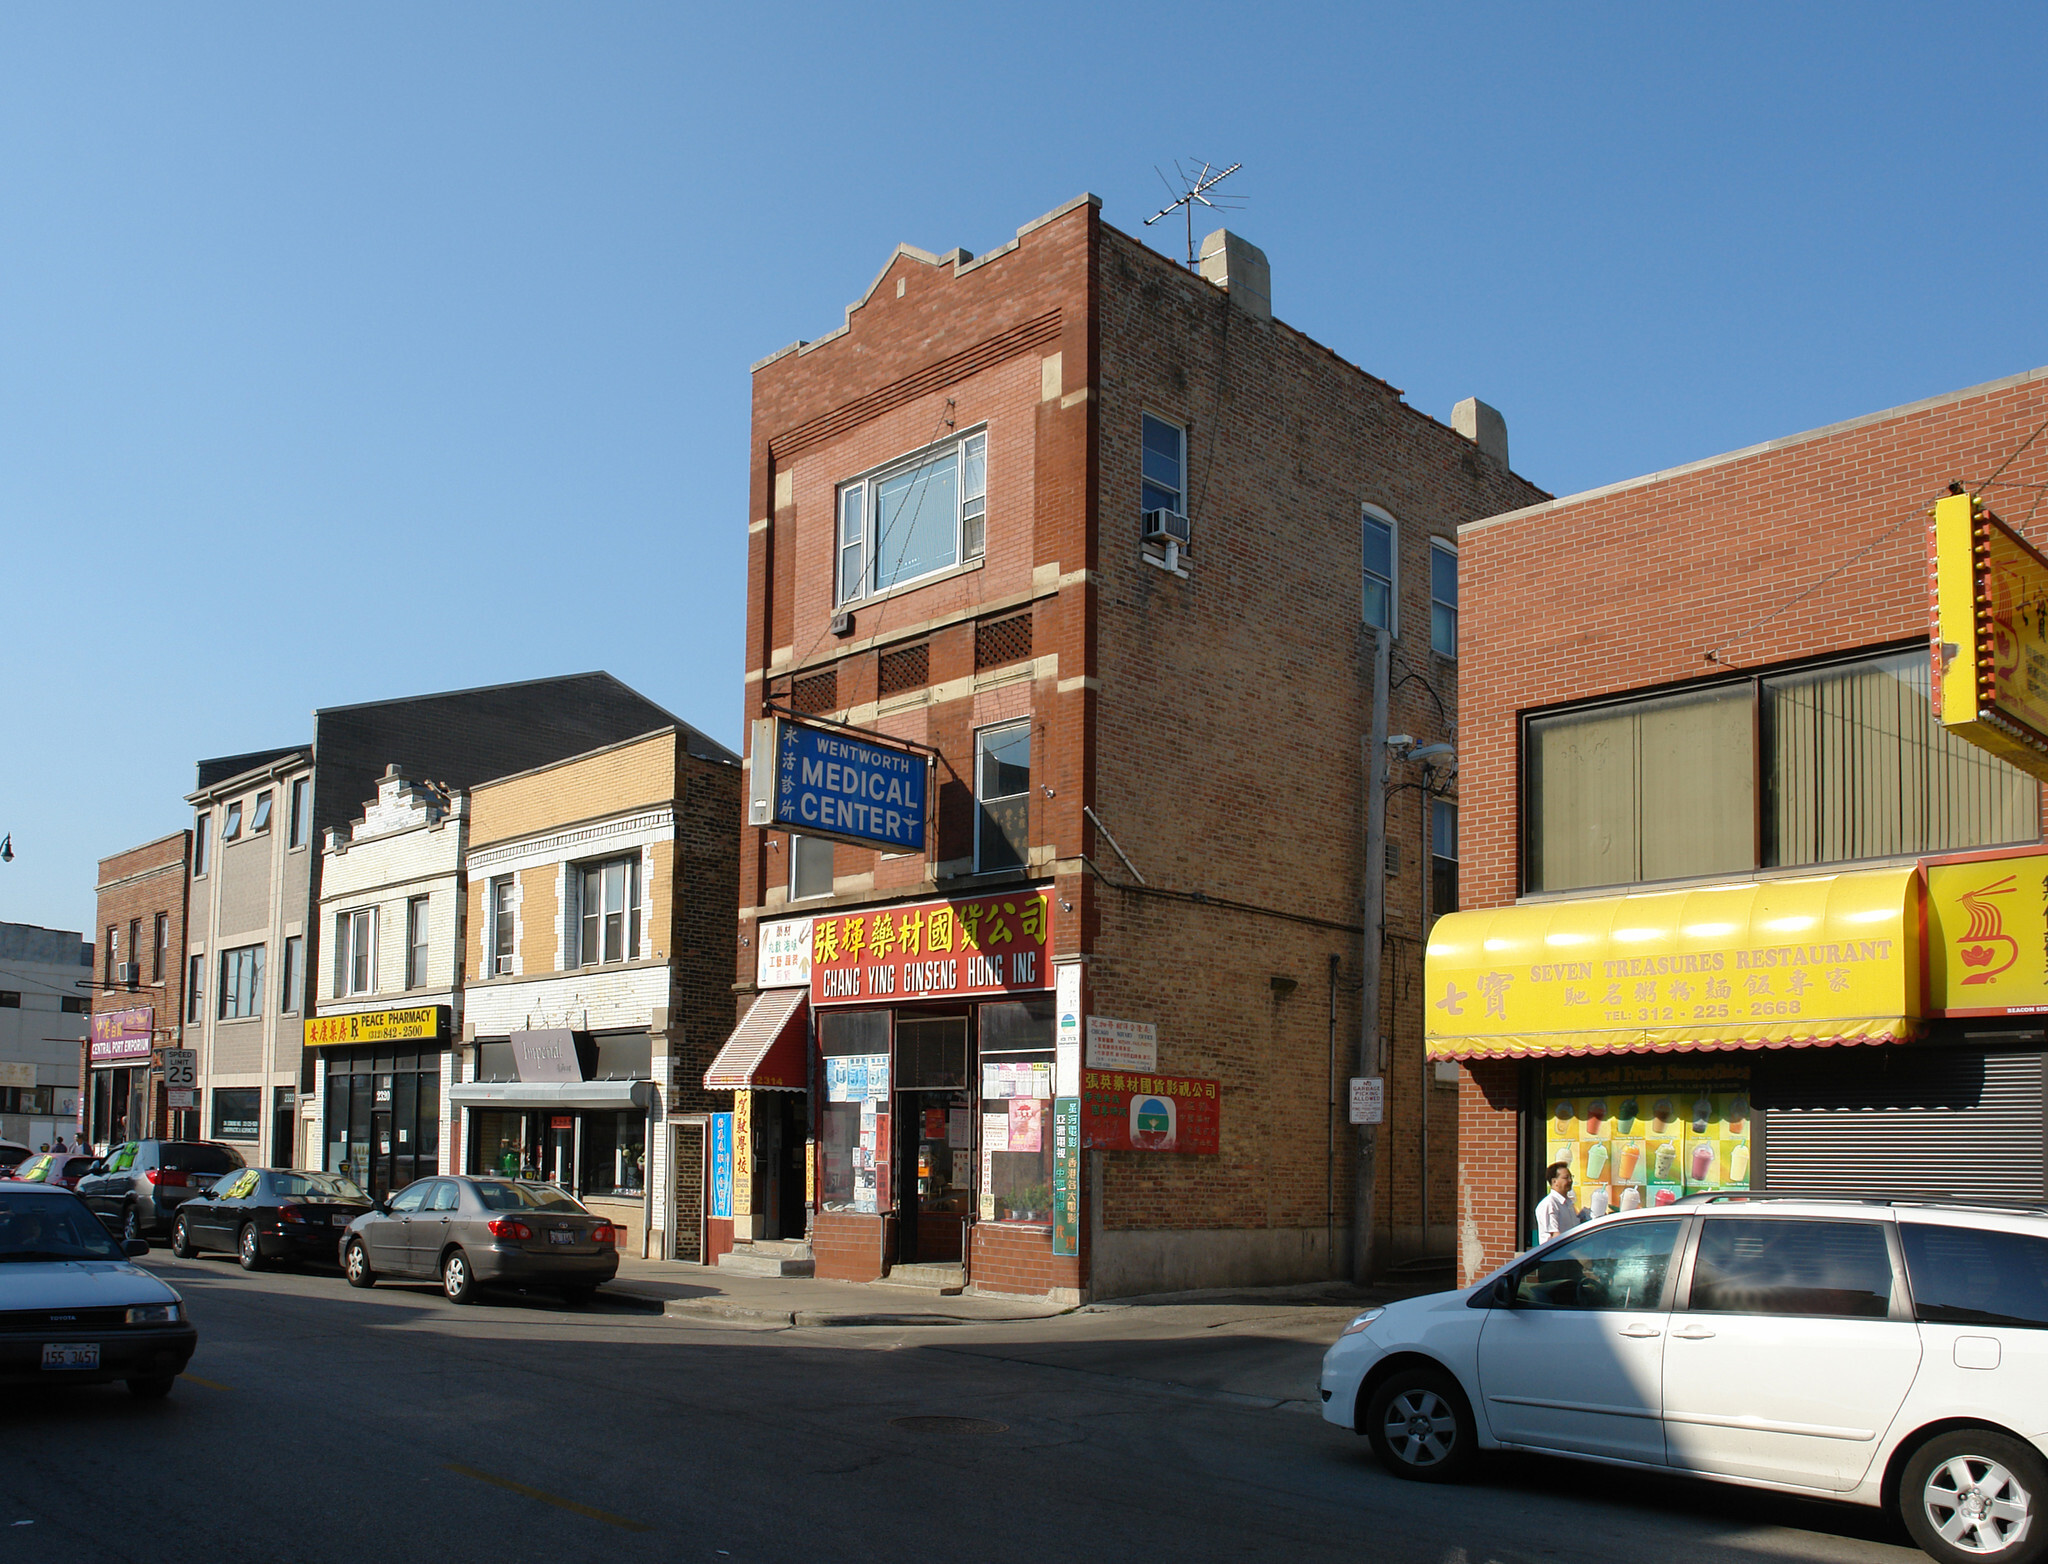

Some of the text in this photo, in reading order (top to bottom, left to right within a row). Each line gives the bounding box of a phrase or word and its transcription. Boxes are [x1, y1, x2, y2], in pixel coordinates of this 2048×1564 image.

[816, 737, 910, 774] WENTWORTH
[801, 756, 918, 809] MEDICAL
[800, 792, 901, 839] CENTER
[823, 951, 1036, 997] CHANG YING GINSENG HONG INC
[1530, 939, 1893, 983] SEVEN TREASURES RESTAURANT
[1435, 971, 1515, 1021] 七寶
[361, 1009, 431, 1027] PEACE PHARMACY
[1604, 1011, 1632, 1022] TEL:
[1637, 1006, 1674, 1022] 312
[1693, 1003, 1729, 1019] 225
[1750, 999, 1801, 1016] 2668
[92, 1038, 149, 1055] CENTRAL PORT EMPORIUM
[522, 1038, 563, 1069] Imperial
[168, 1066, 193, 1083] 25
[757, 1076, 782, 1086] 2314
[1587, 1067, 1619, 1084] Real
[1624, 1065, 1662, 1082] Fruit
[1667, 1062, 1751, 1081] Smoothies
[46, 1351, 64, 1364] 155
